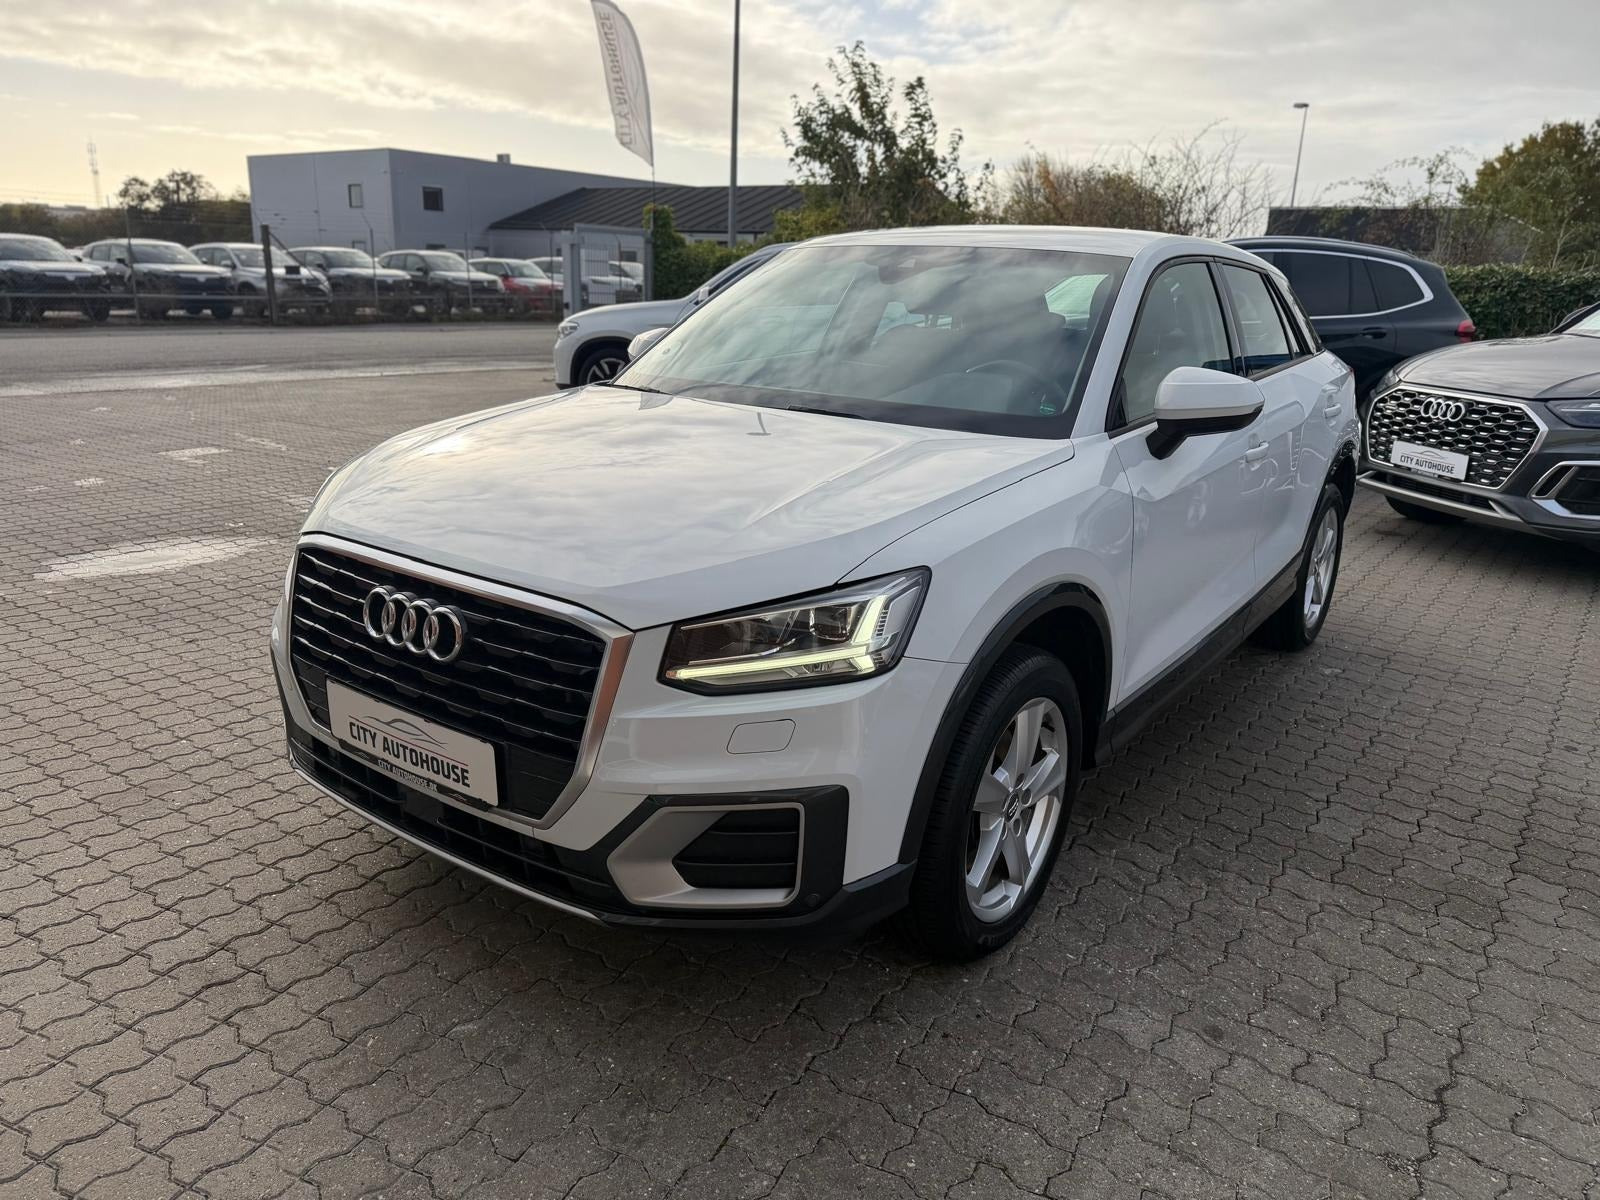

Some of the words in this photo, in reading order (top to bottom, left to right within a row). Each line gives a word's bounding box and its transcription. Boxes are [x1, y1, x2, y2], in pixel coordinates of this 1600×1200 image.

[1400, 455, 1414, 465] CITY
[1415, 459, 1455, 474] AUTOHOUSE
[349, 721, 377, 748] CITY
[382, 737, 471, 788] AUTOHOUSE
[378, 760, 391, 771] CITY
